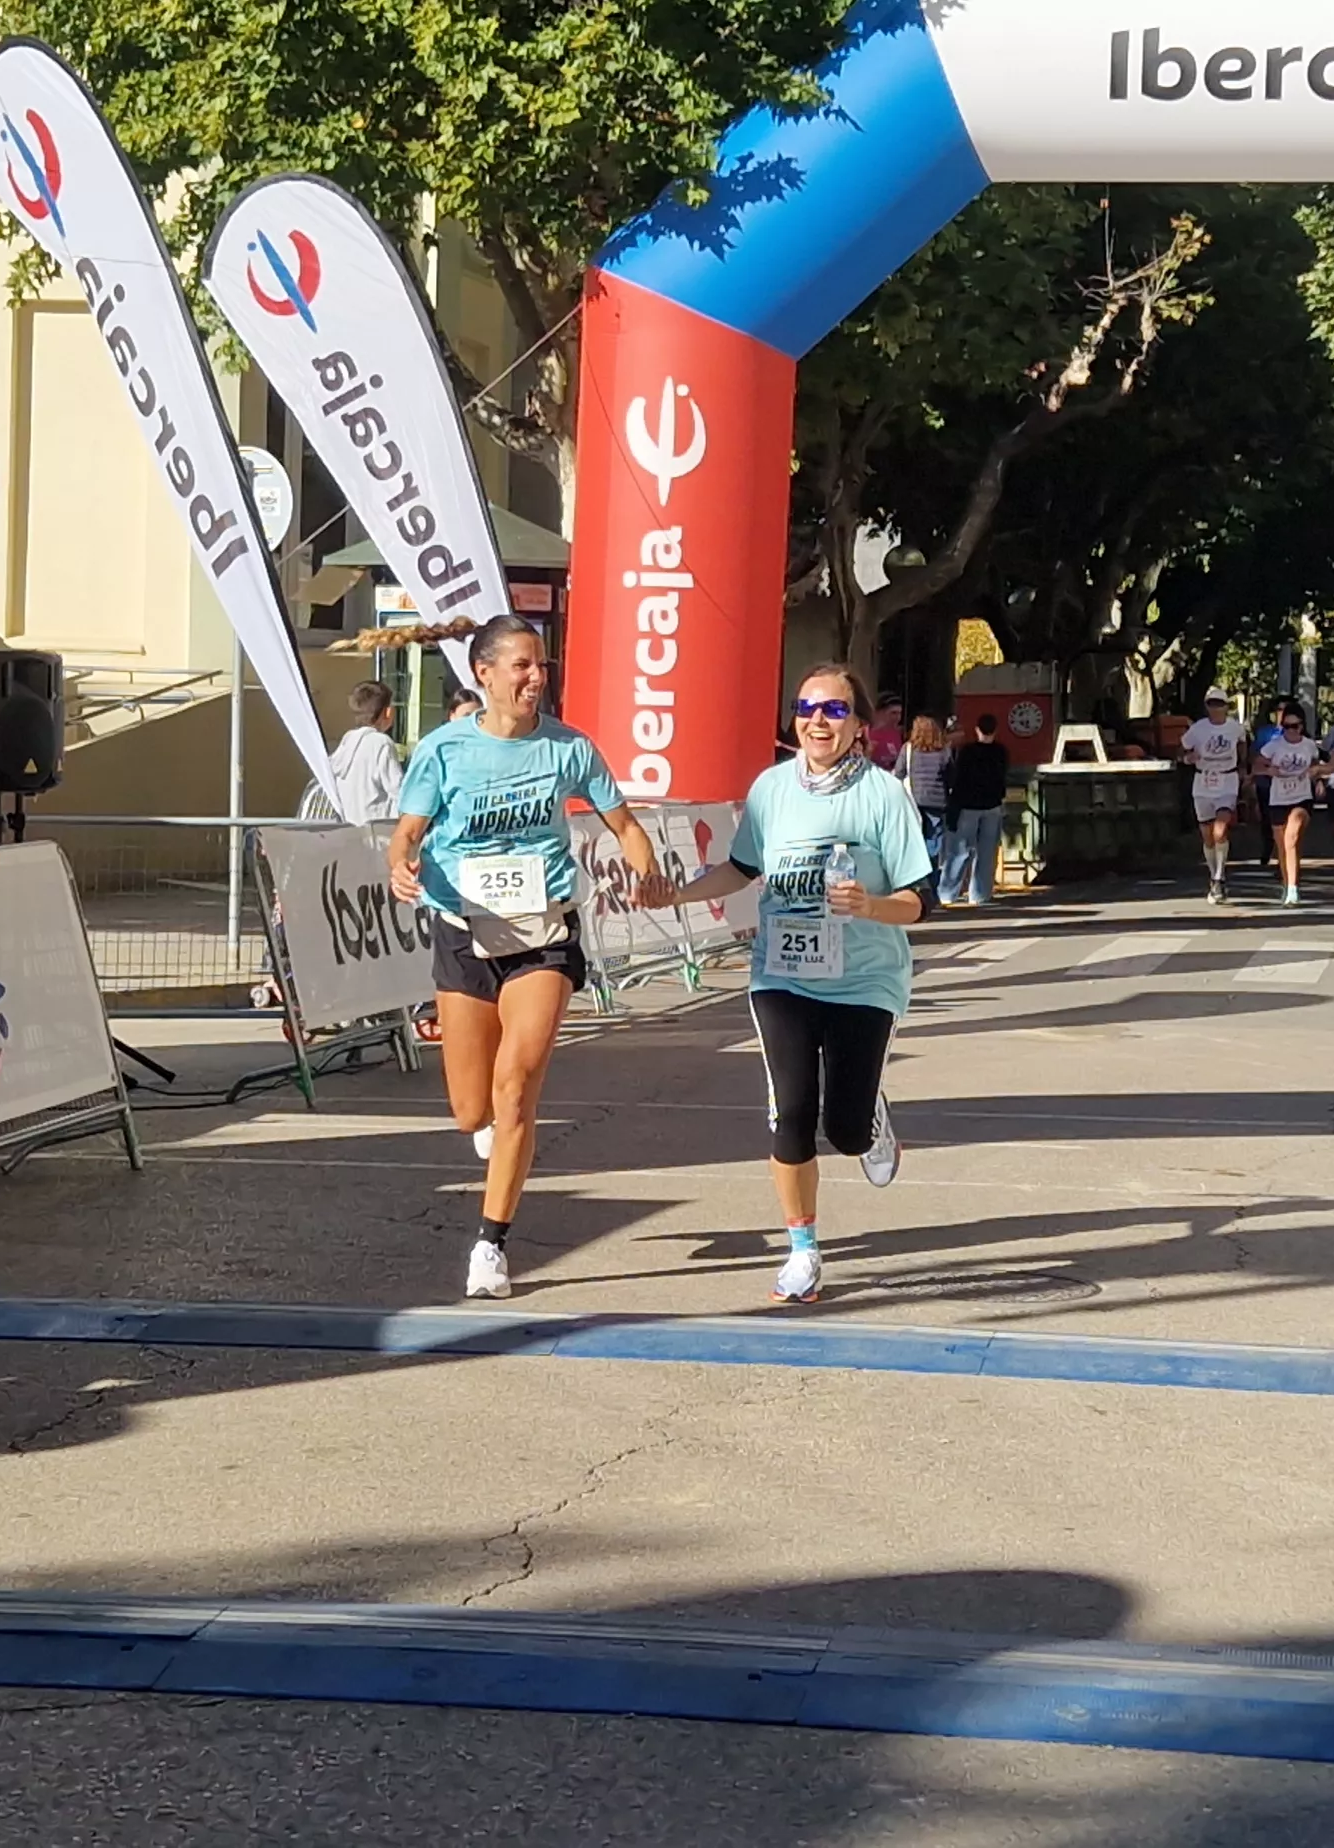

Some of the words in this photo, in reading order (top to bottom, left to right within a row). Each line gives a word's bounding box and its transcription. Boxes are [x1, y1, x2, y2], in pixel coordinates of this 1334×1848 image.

[617, 525, 695, 799] bercaja
[463, 796, 555, 838] MPRESAS
[479, 871, 525, 891] 255
[782, 933, 820, 953] 251
